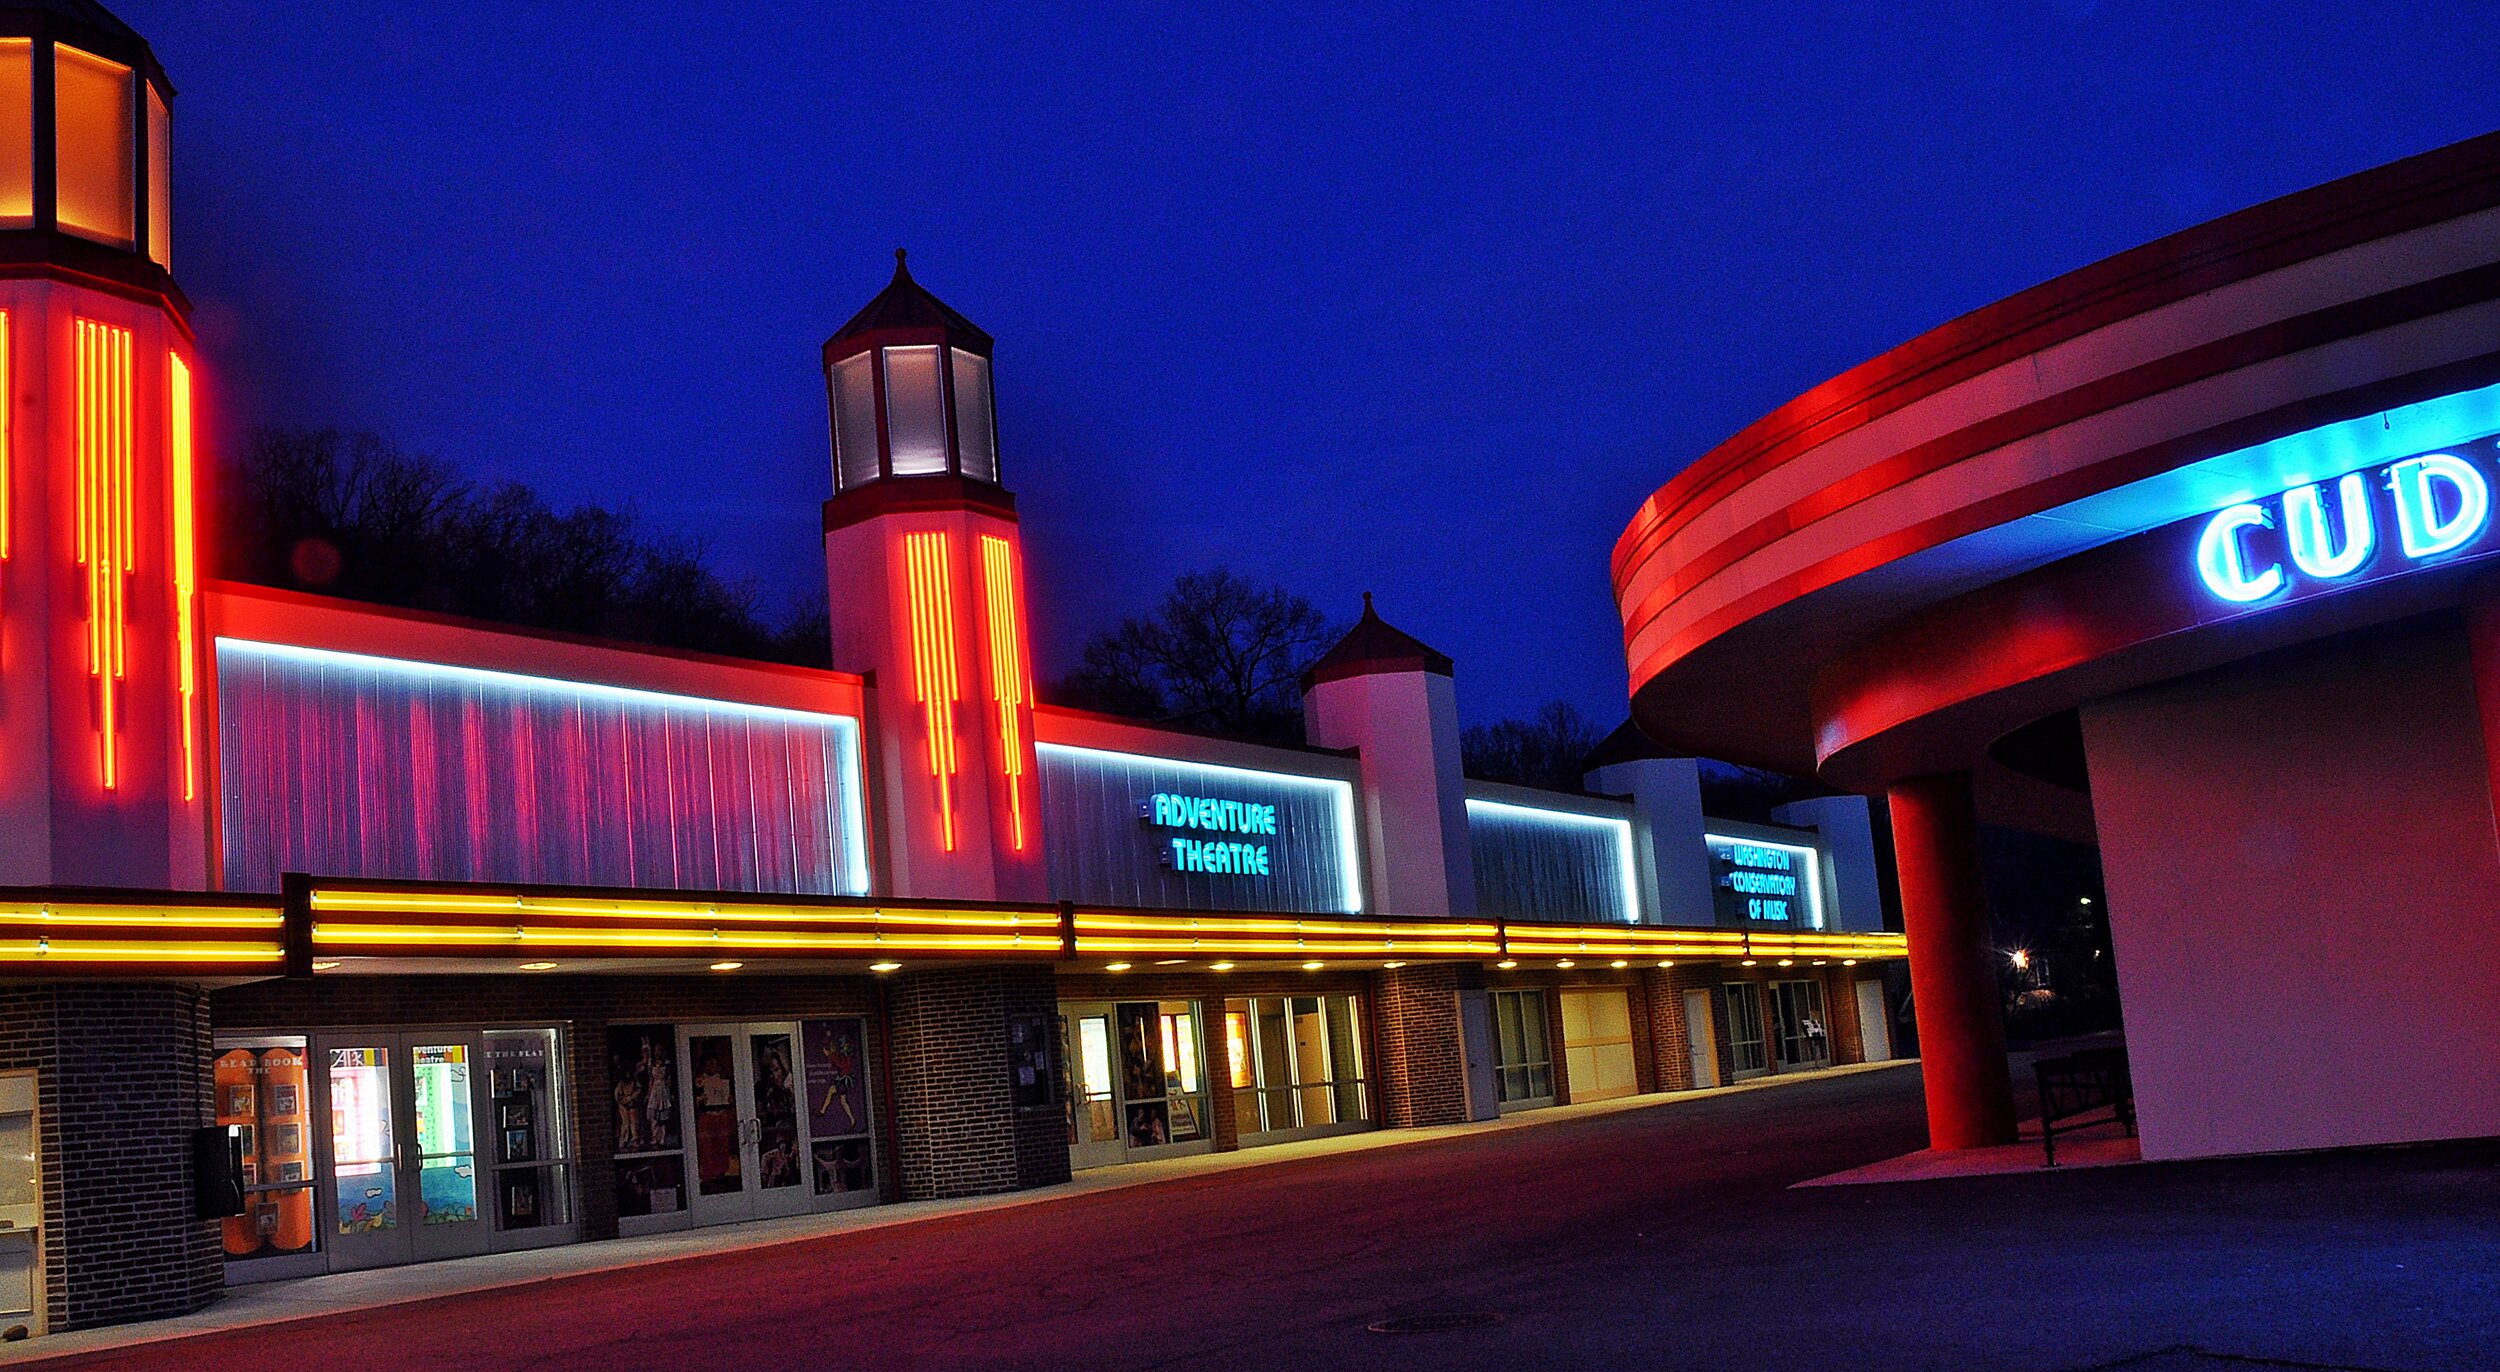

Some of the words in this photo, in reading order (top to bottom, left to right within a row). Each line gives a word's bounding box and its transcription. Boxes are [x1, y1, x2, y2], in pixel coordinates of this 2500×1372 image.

[2197, 453, 2490, 603] CUD
[1153, 793, 1276, 835] ADVENTURE
[1172, 837, 1270, 876] THEATRE
[1733, 844, 1789, 871] WASHINGTON
[1733, 871, 1796, 896] CONSERVATORY
[1748, 898, 1762, 920] OF
[1763, 899, 1789, 921] MUSIC
